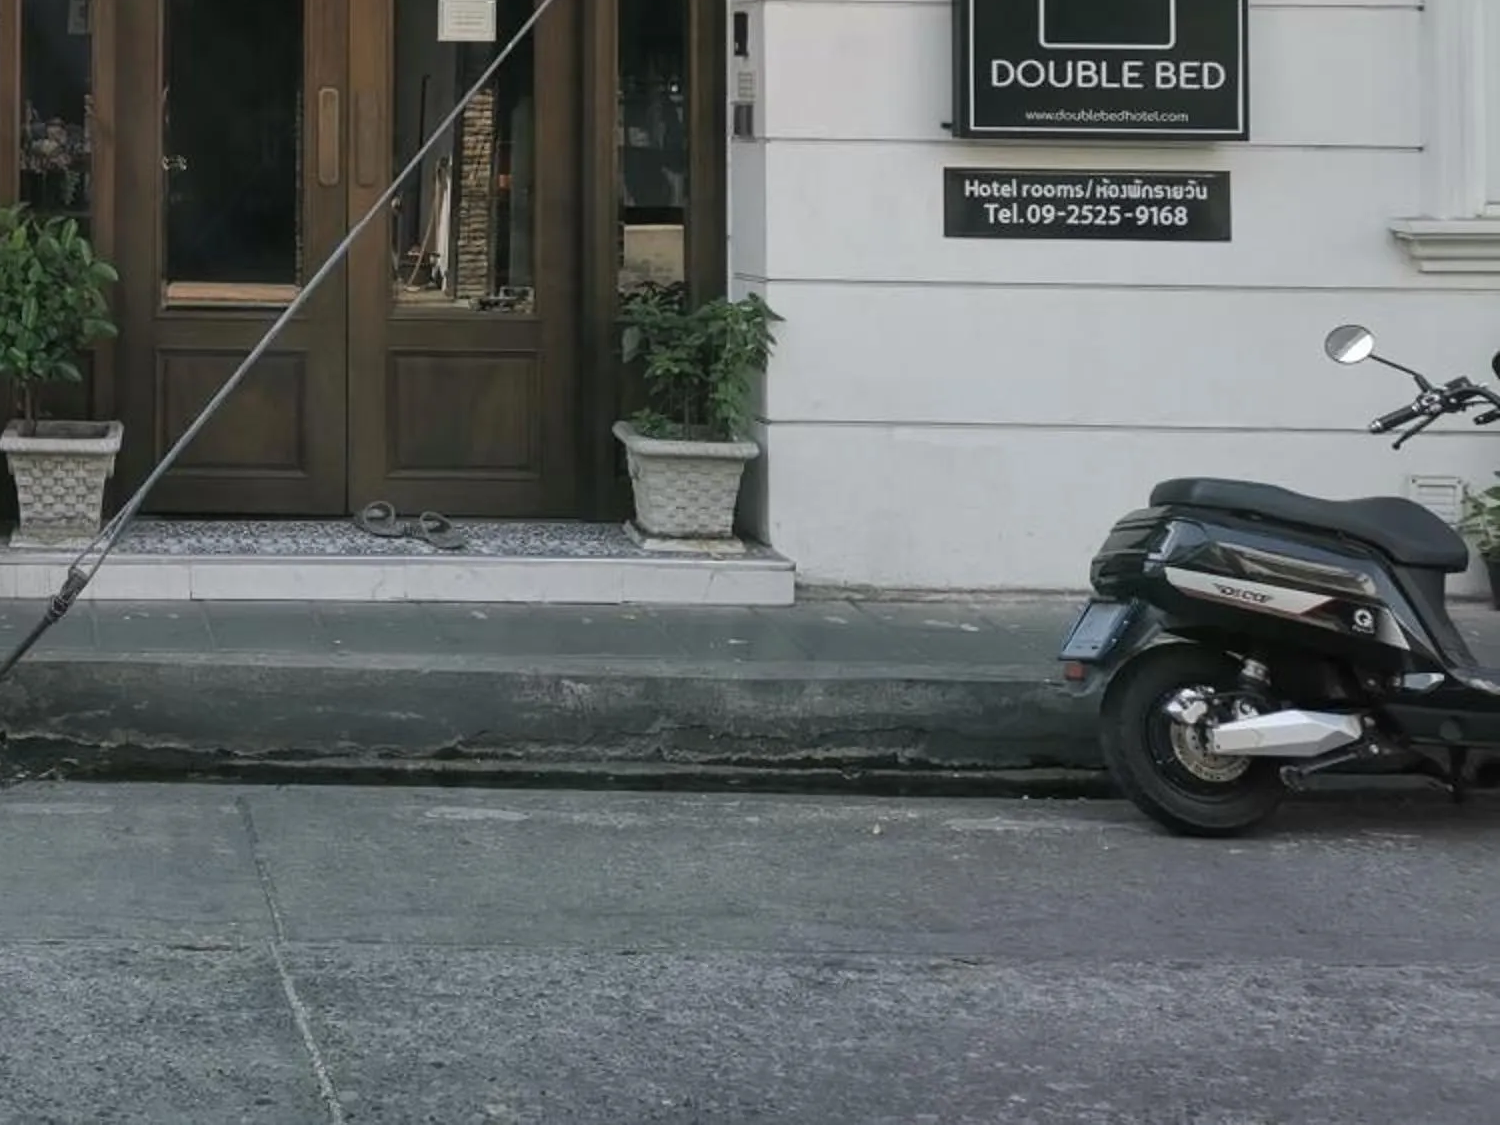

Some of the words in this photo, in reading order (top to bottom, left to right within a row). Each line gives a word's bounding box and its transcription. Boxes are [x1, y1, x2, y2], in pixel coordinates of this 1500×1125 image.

[990, 58, 1145, 89] DOUBLE
[1155, 61, 1227, 90] BED
[1025, 109, 1189, 123] www.doublebedhotel.com
[964, 178, 1017, 198] Hotel
